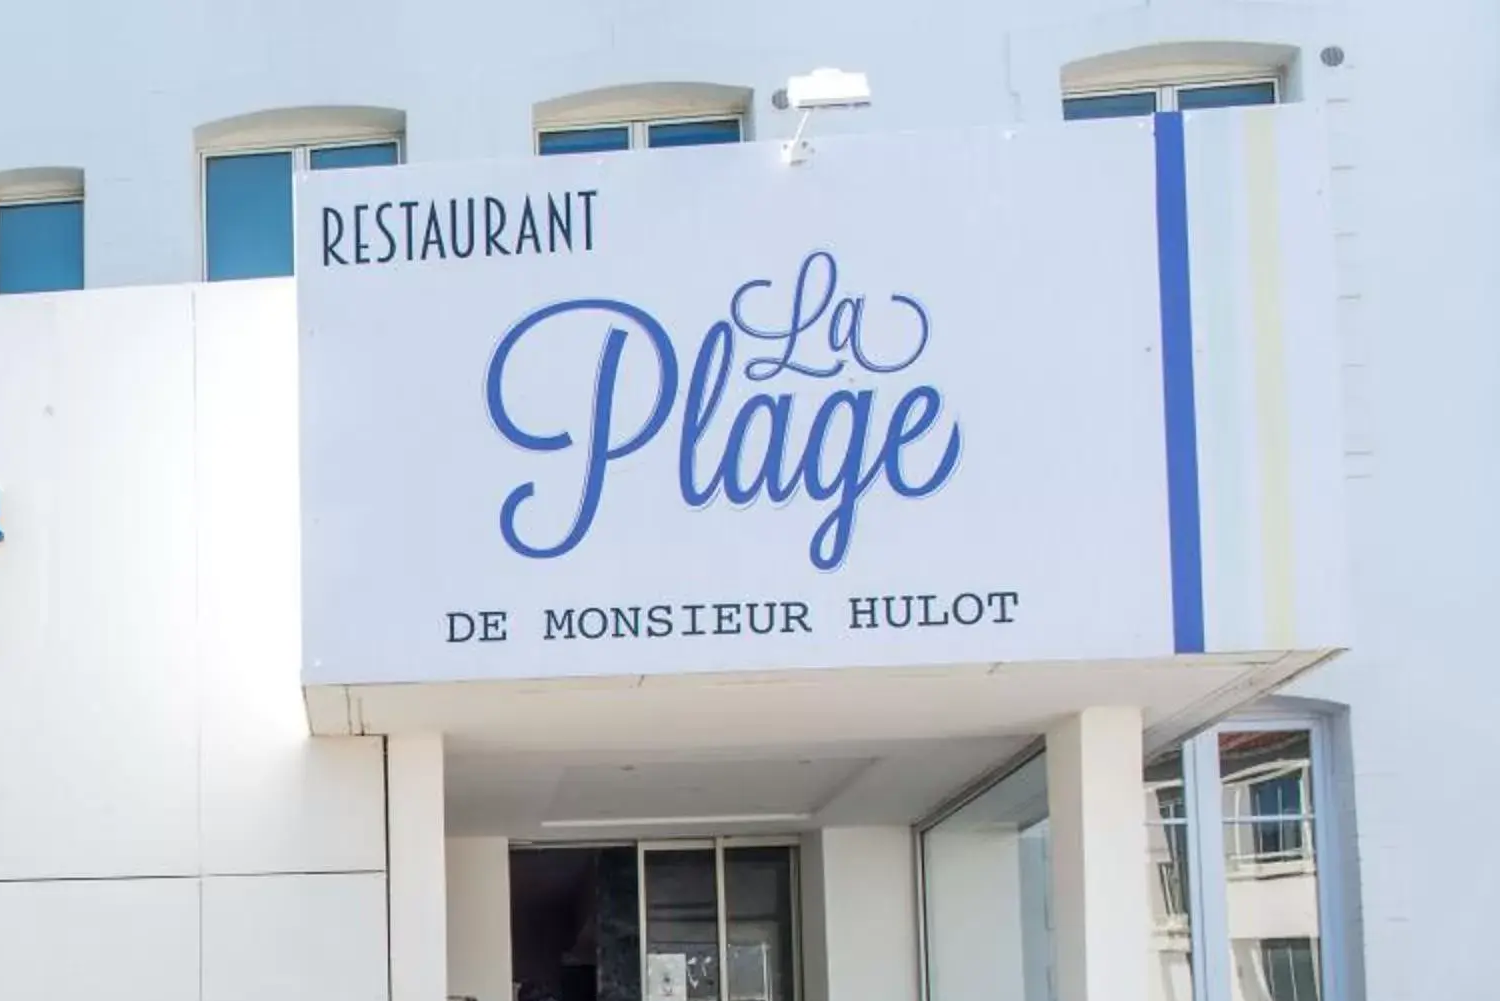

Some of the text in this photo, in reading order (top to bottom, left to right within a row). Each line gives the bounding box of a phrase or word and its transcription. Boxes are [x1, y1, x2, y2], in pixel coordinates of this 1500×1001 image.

[321, 190, 598, 267] RESTAURANT
[731, 251, 929, 381] La
[485, 298, 961, 571] Plage
[445, 592, 1020, 644] DE MONSIEUR HULOT
